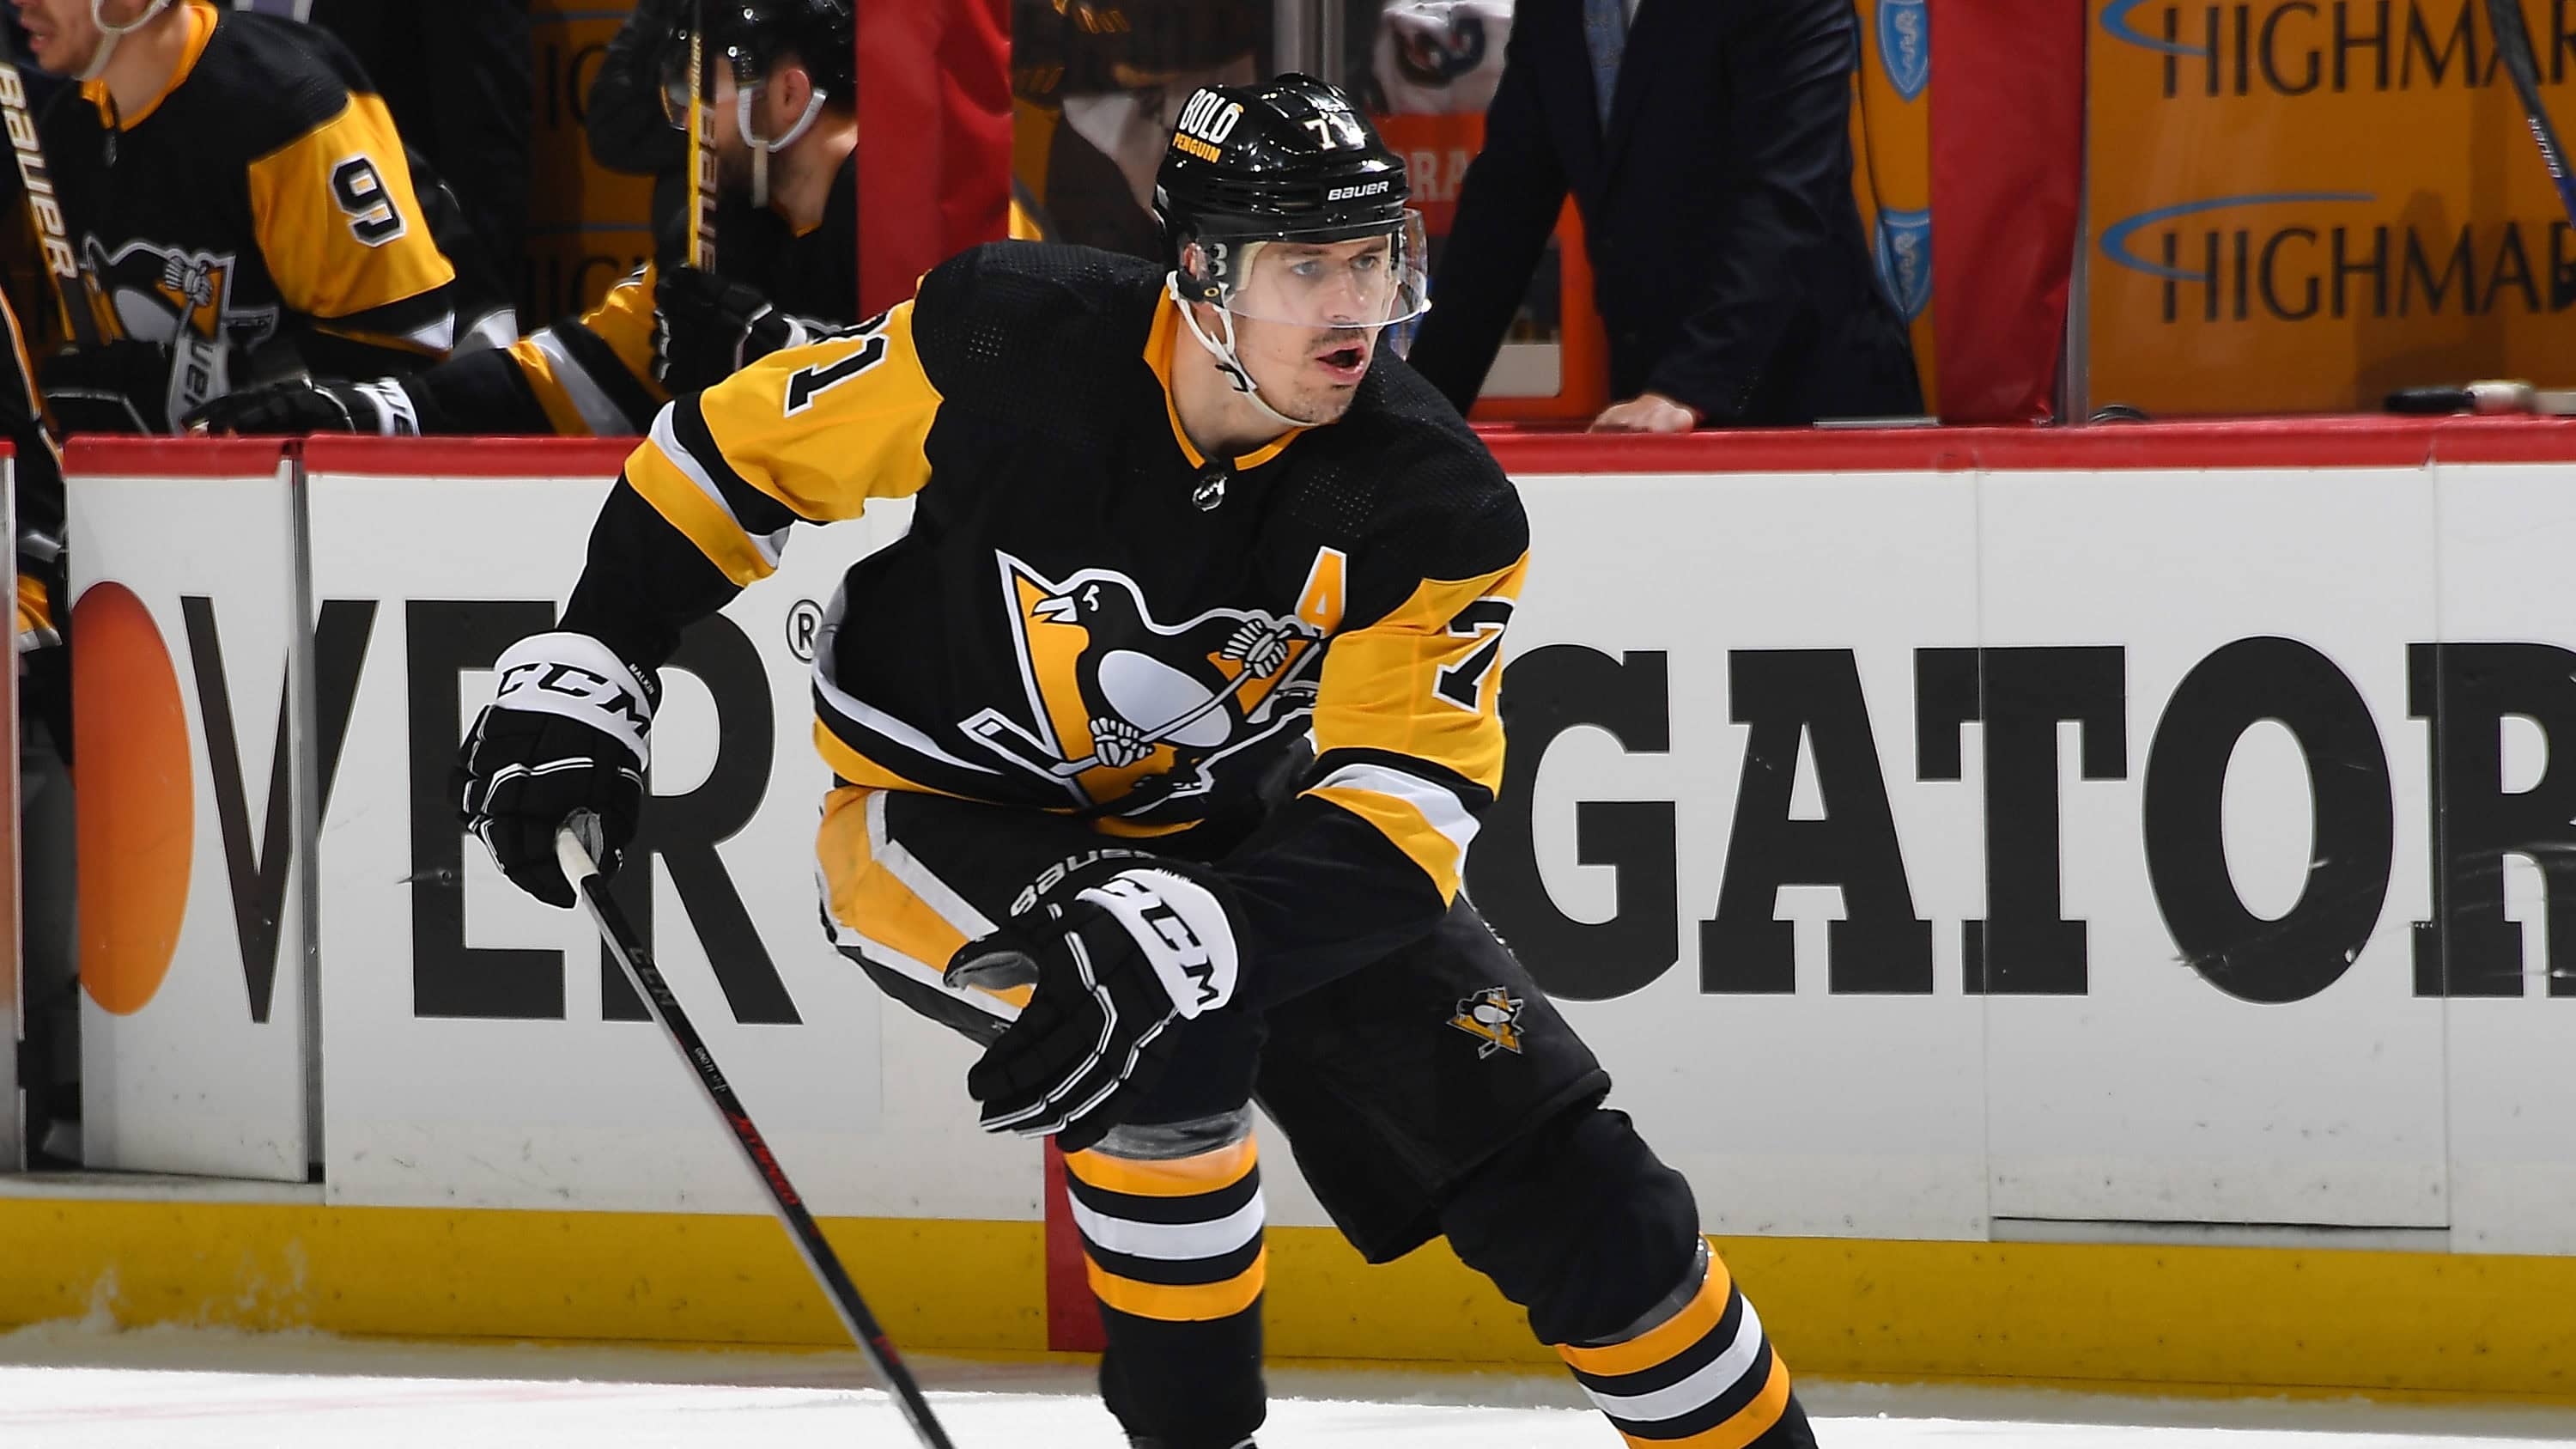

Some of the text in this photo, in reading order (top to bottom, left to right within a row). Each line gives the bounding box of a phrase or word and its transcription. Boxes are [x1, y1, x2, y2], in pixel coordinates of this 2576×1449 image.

[1172, 132, 1222, 163] PENGUIN
[1178, 88, 1243, 144] BOLD
[0, 64, 78, 279] BAUER
[330, 152, 406, 248] 9
[1327, 181, 1389, 201] BAUER
[1294, 545, 1346, 639] A
[497, 662, 651, 740] CCM
[628, 663, 655, 695] MALKIN
